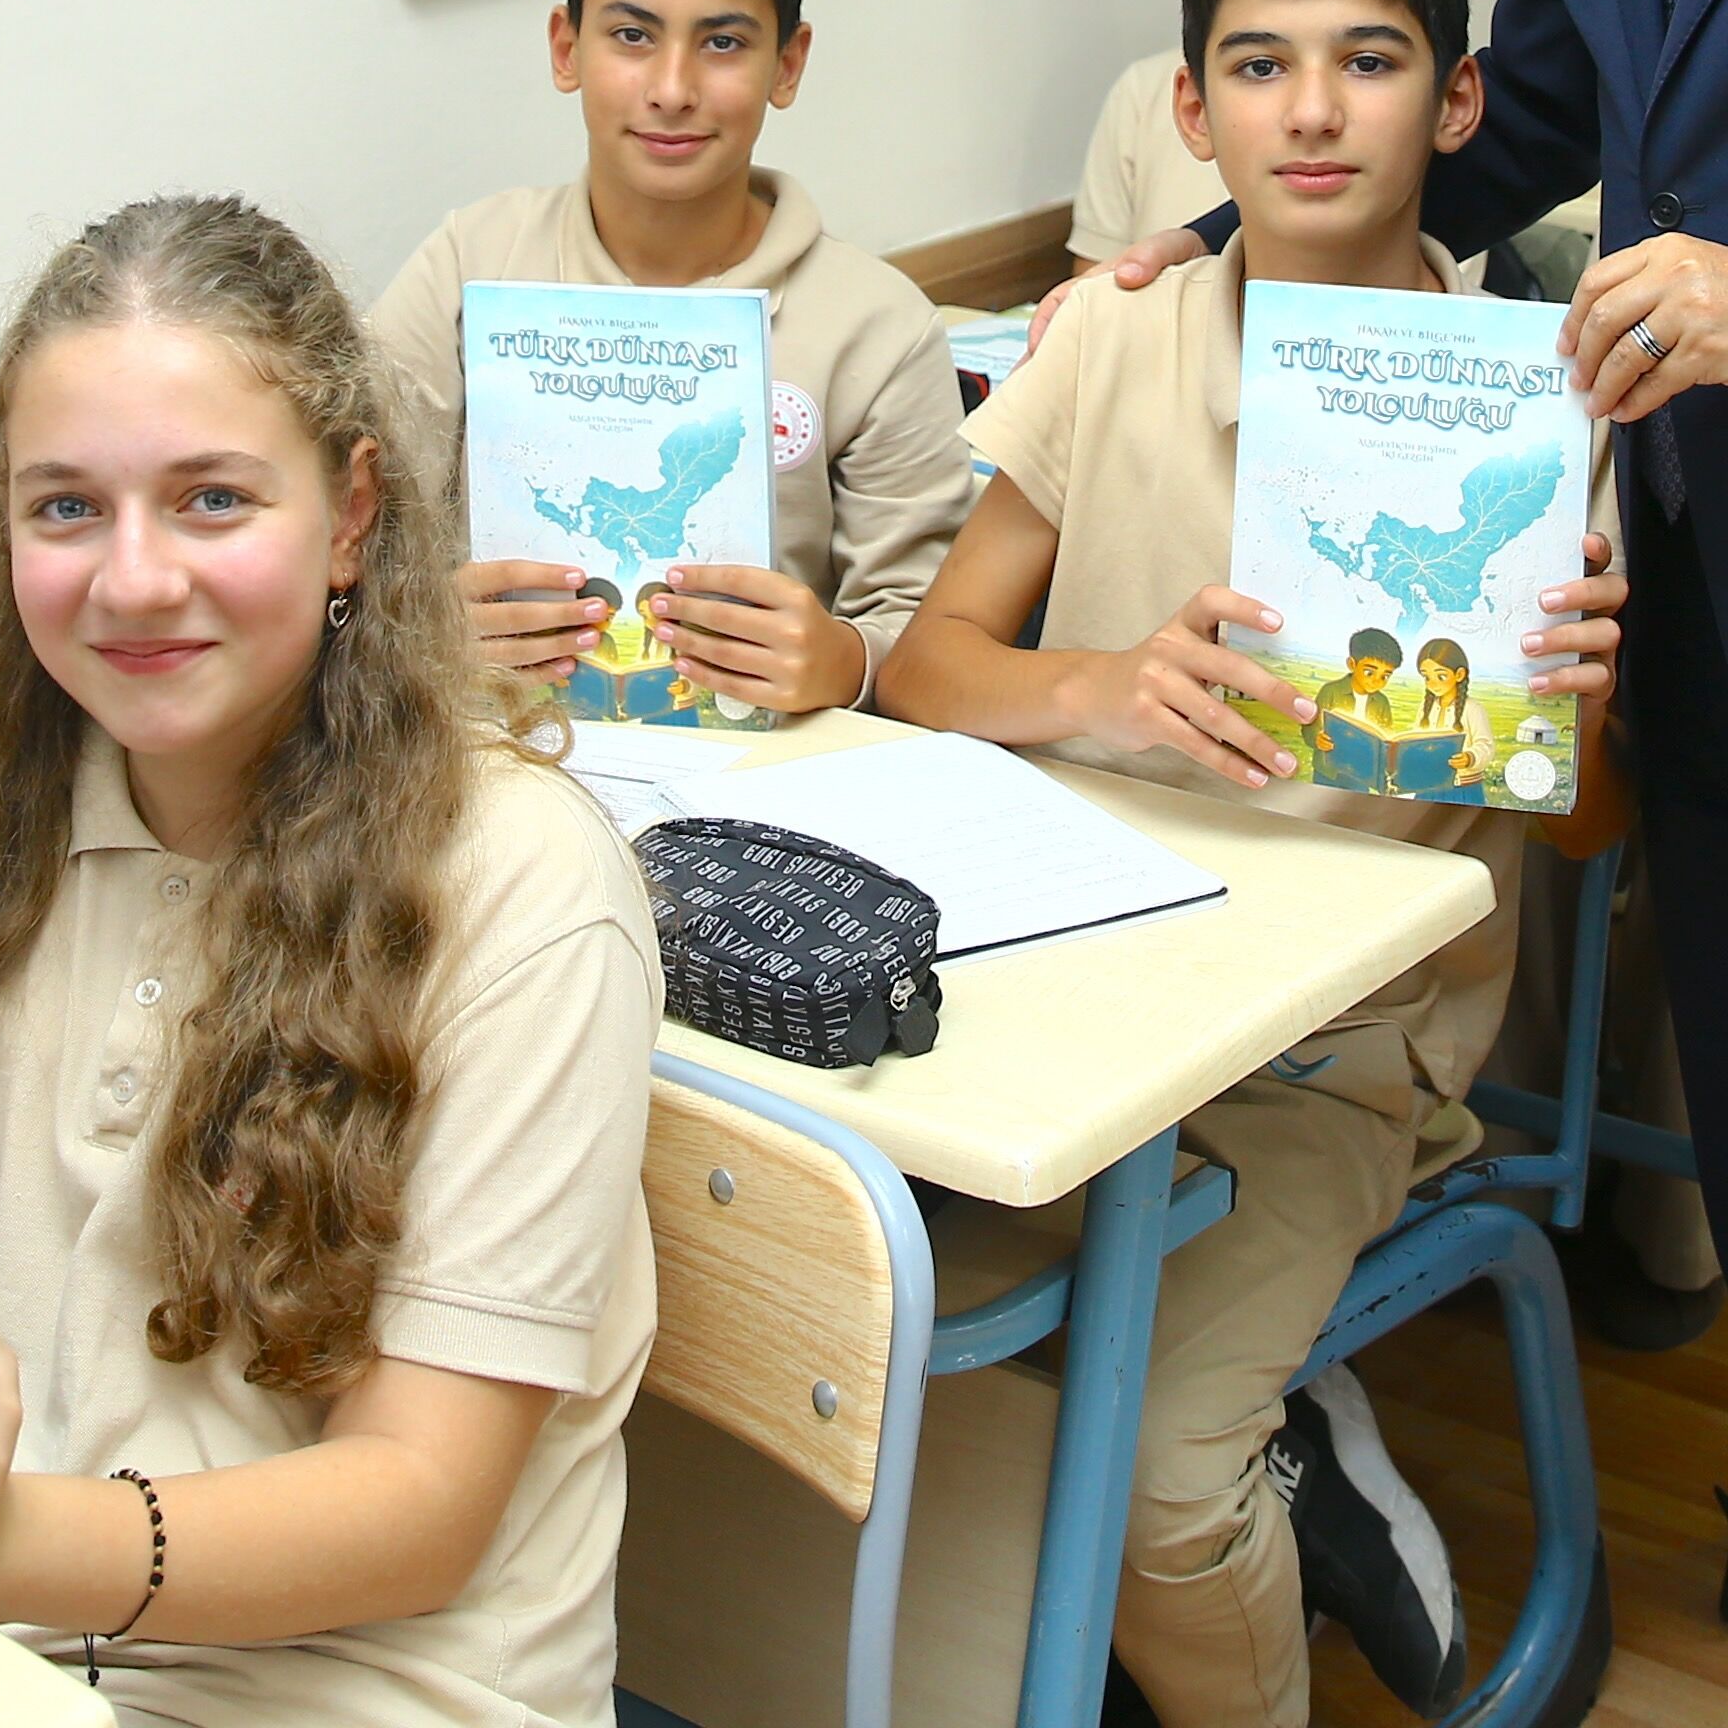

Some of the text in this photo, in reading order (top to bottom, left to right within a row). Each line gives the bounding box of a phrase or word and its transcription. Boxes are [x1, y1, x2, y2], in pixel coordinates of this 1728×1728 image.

[489, 329, 738, 373] TÜRK DÜNYASI
[1272, 337, 1565, 397] TÜRK DÜNYASI
[529, 371, 700, 405] YOLCULUĞU
[1317, 385, 1517, 433] YOLCULUĞU
[690, 856, 738, 884] 1903
[742, 843, 787, 869] 1903
[821, 905, 869, 943] 1903
[874, 896, 918, 923] 1903
[754, 950, 801, 980] 1903
